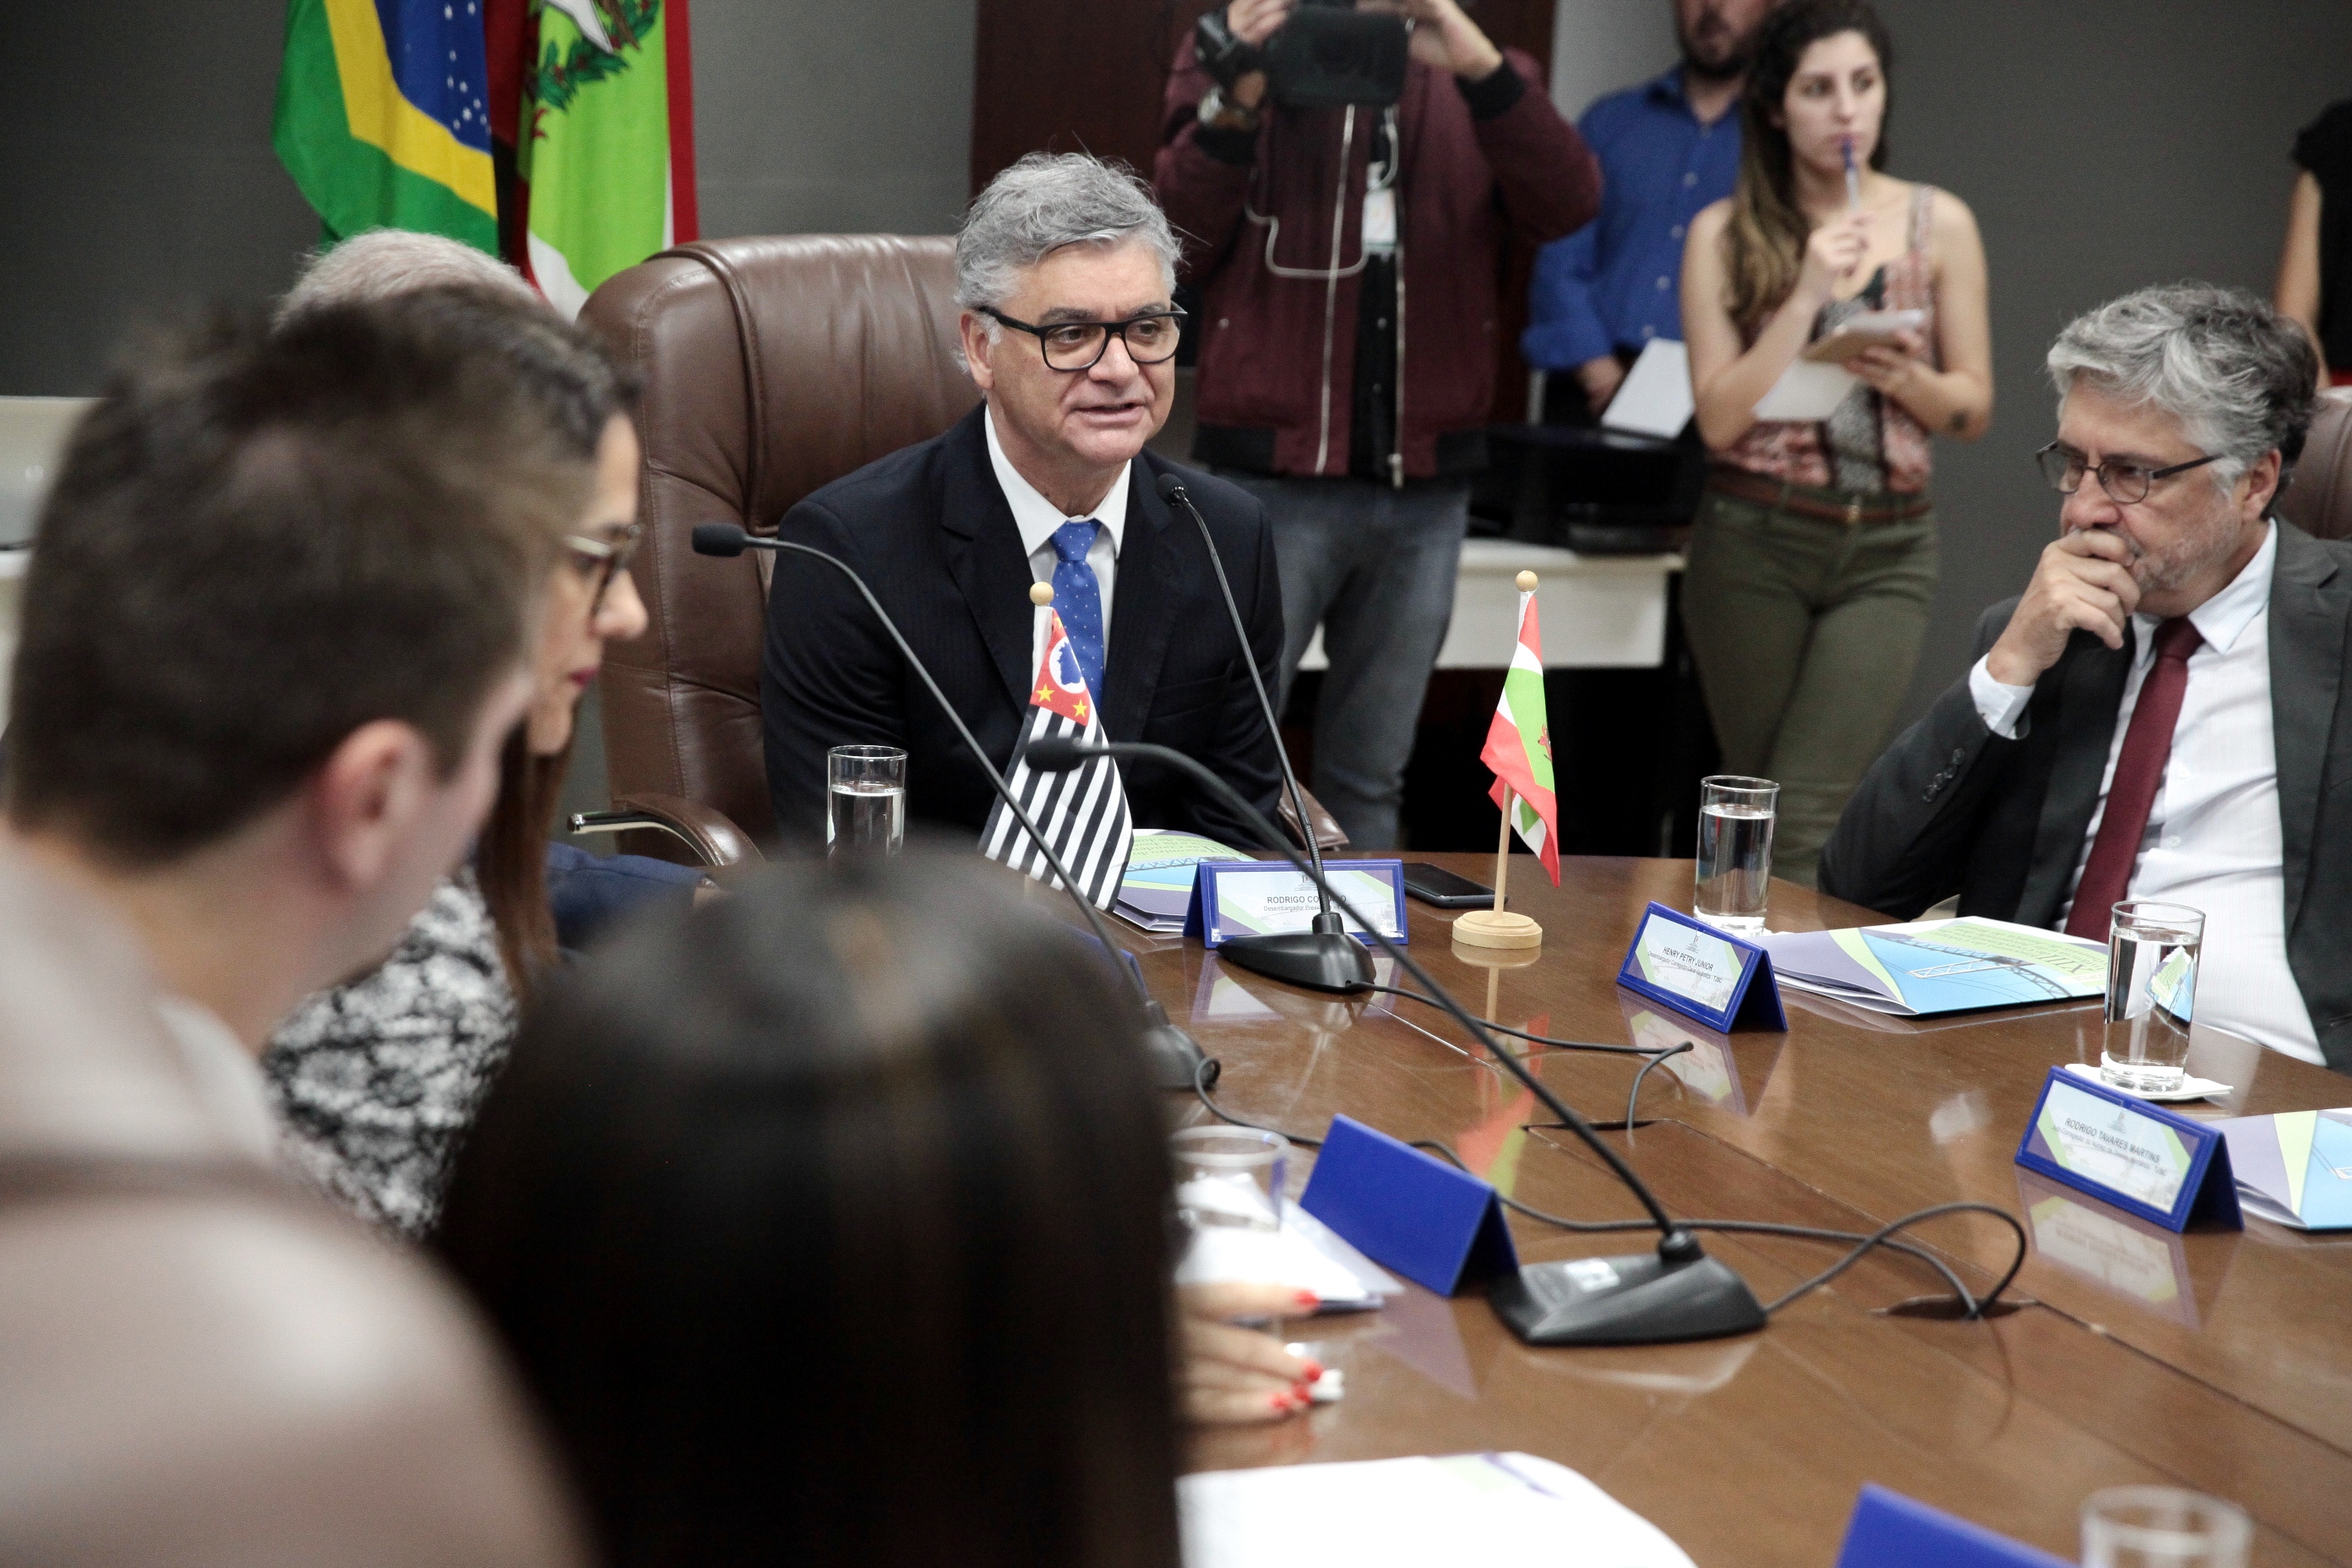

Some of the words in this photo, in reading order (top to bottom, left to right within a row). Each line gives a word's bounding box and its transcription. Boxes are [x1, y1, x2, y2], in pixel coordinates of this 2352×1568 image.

[1267, 896, 1305, 904] RODRIGO
[1663, 946, 1680, 959] HENRY
[1679, 952, 1696, 965] PETRY
[1695, 959, 1713, 971] JUNIOR
[2065, 1118, 2098, 1136] RODRIGO
[2098, 1130, 2129, 1150] TAVARES
[2129, 1144, 2160, 1163] MARTINS
